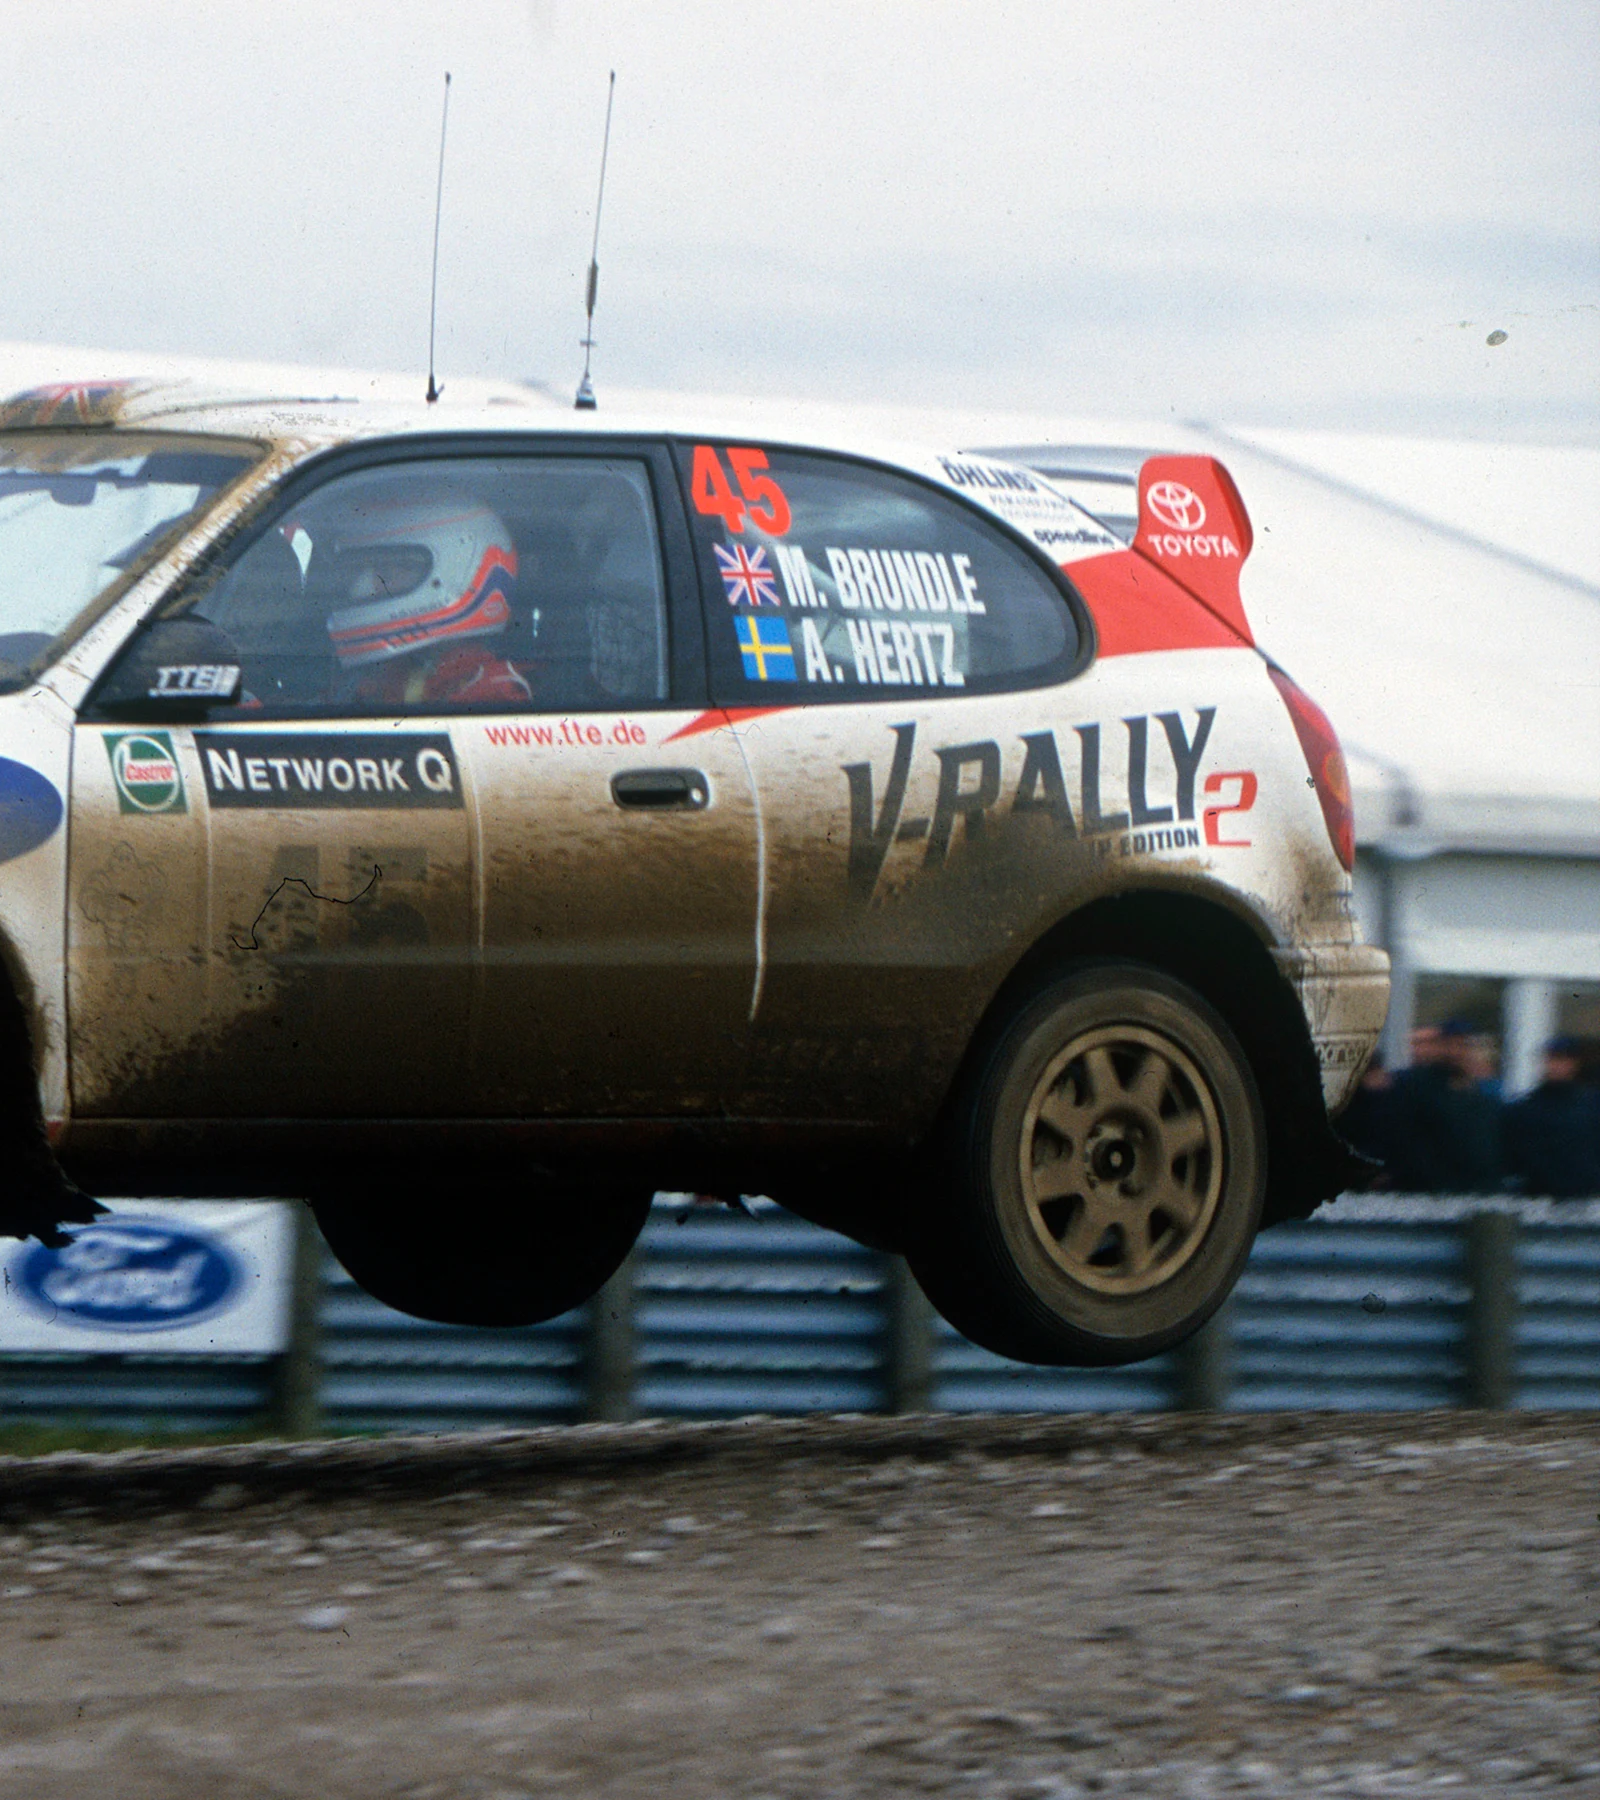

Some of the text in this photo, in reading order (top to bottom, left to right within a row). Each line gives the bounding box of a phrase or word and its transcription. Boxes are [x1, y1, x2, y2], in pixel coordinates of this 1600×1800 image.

[691, 445, 791, 536] 45
[1147, 534, 1239, 557] TOYOTA
[775, 545, 987, 614] M. BRUNDLE
[801, 617, 966, 686] A. HERTZ
[484, 719, 647, 747] www.tte.de
[125, 763, 174, 782] Castrol
[415, 748, 454, 793] Q
[1203, 772, 1258, 847] 2
[1120, 827, 1201, 856] EDITION
[41, 1230, 207, 1308] Ford
